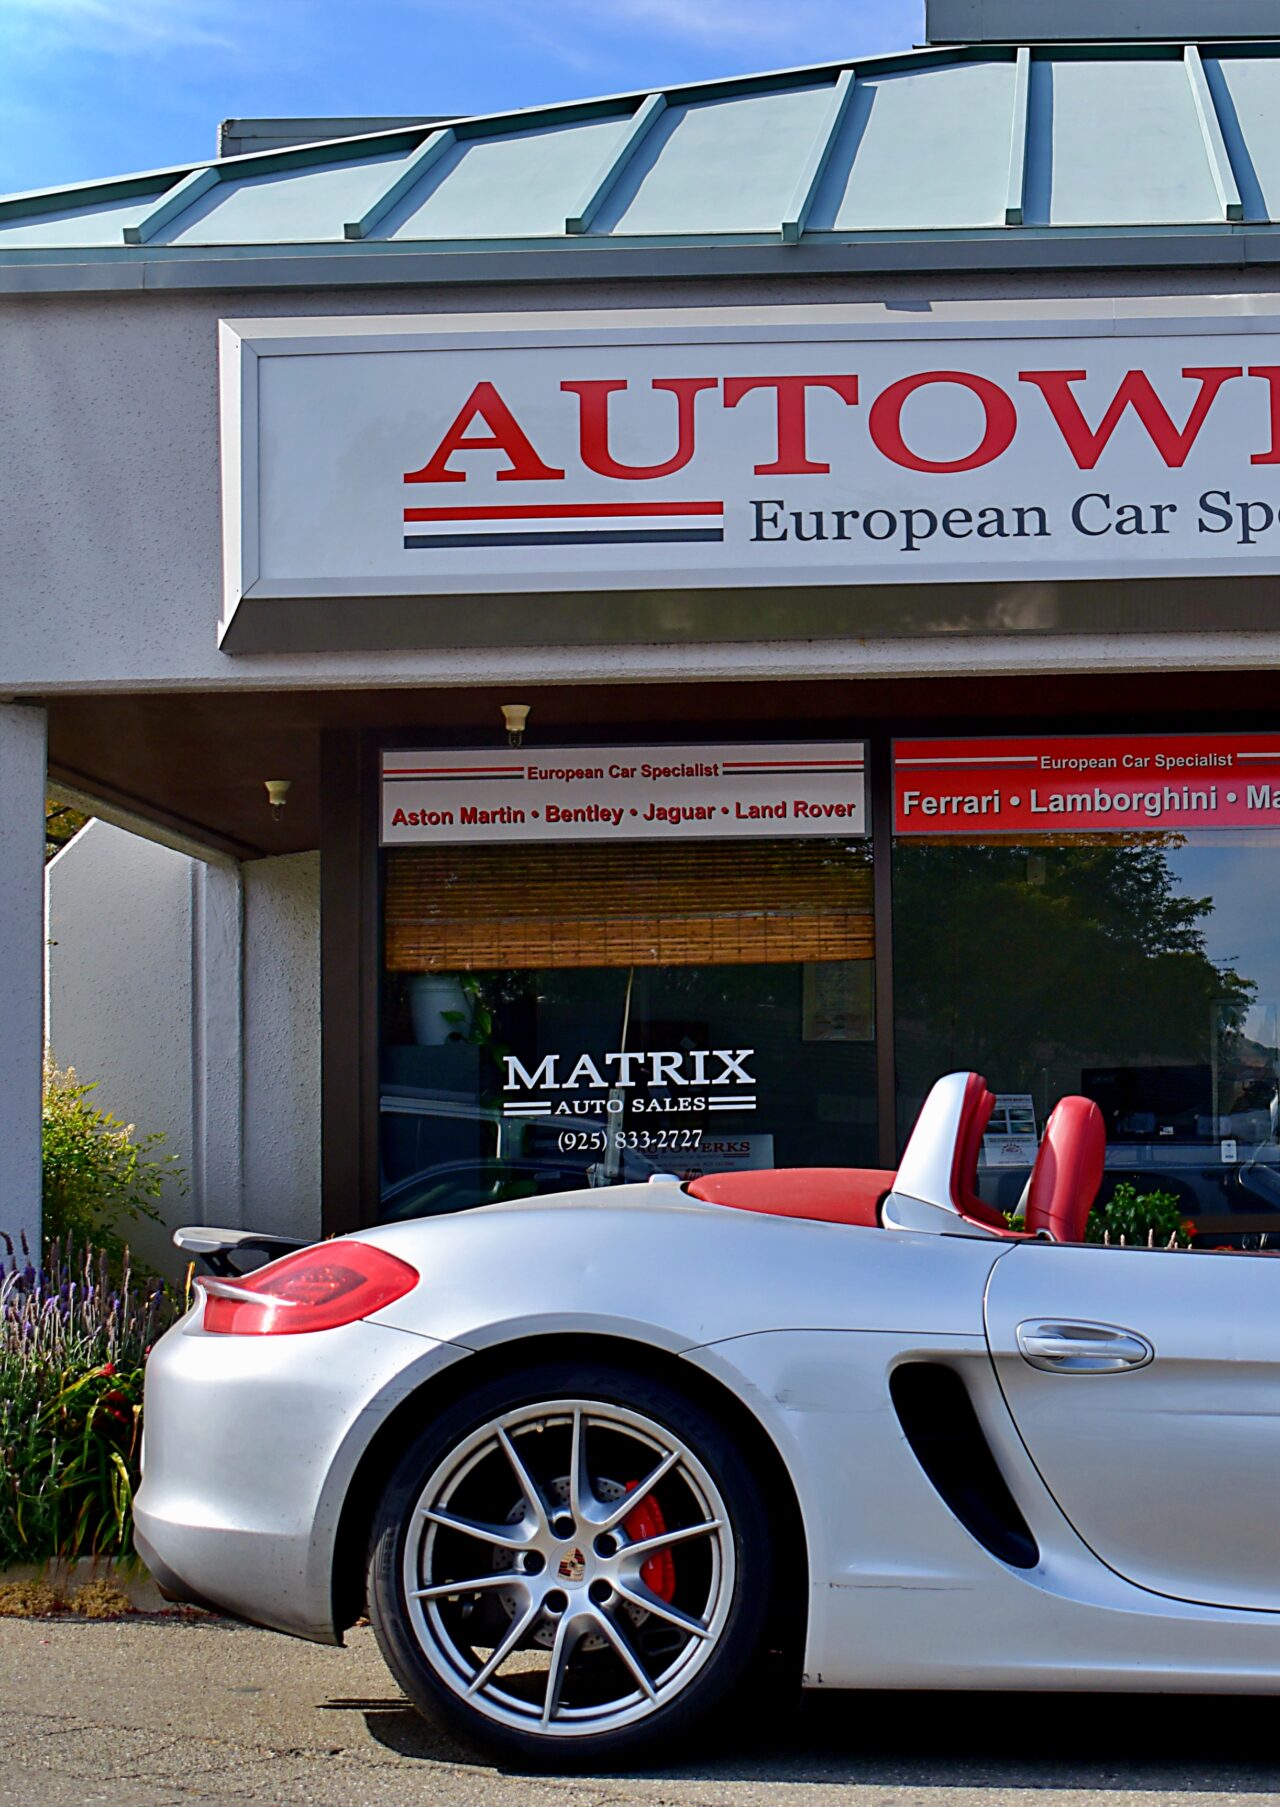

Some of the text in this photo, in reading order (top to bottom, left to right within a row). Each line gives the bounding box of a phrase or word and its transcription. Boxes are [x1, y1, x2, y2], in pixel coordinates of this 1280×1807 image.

[749, 500, 1051, 551] European
[1071, 493, 1177, 537] Car
[527, 763, 719, 782] European Car Specialist
[1040, 753, 1233, 771] European Car Specialist
[392, 800, 856, 826] Aston Martin Bentley Jaguar Land Rover
[903, 789, 1000, 815] Ferrari
[1030, 785, 1217, 817] Lamborghini
[503, 1050, 756, 1091] MATRIX
[554, 1097, 706, 1115] AUTO SALES
[558, 1129, 703, 1152] (925) 833-2727
